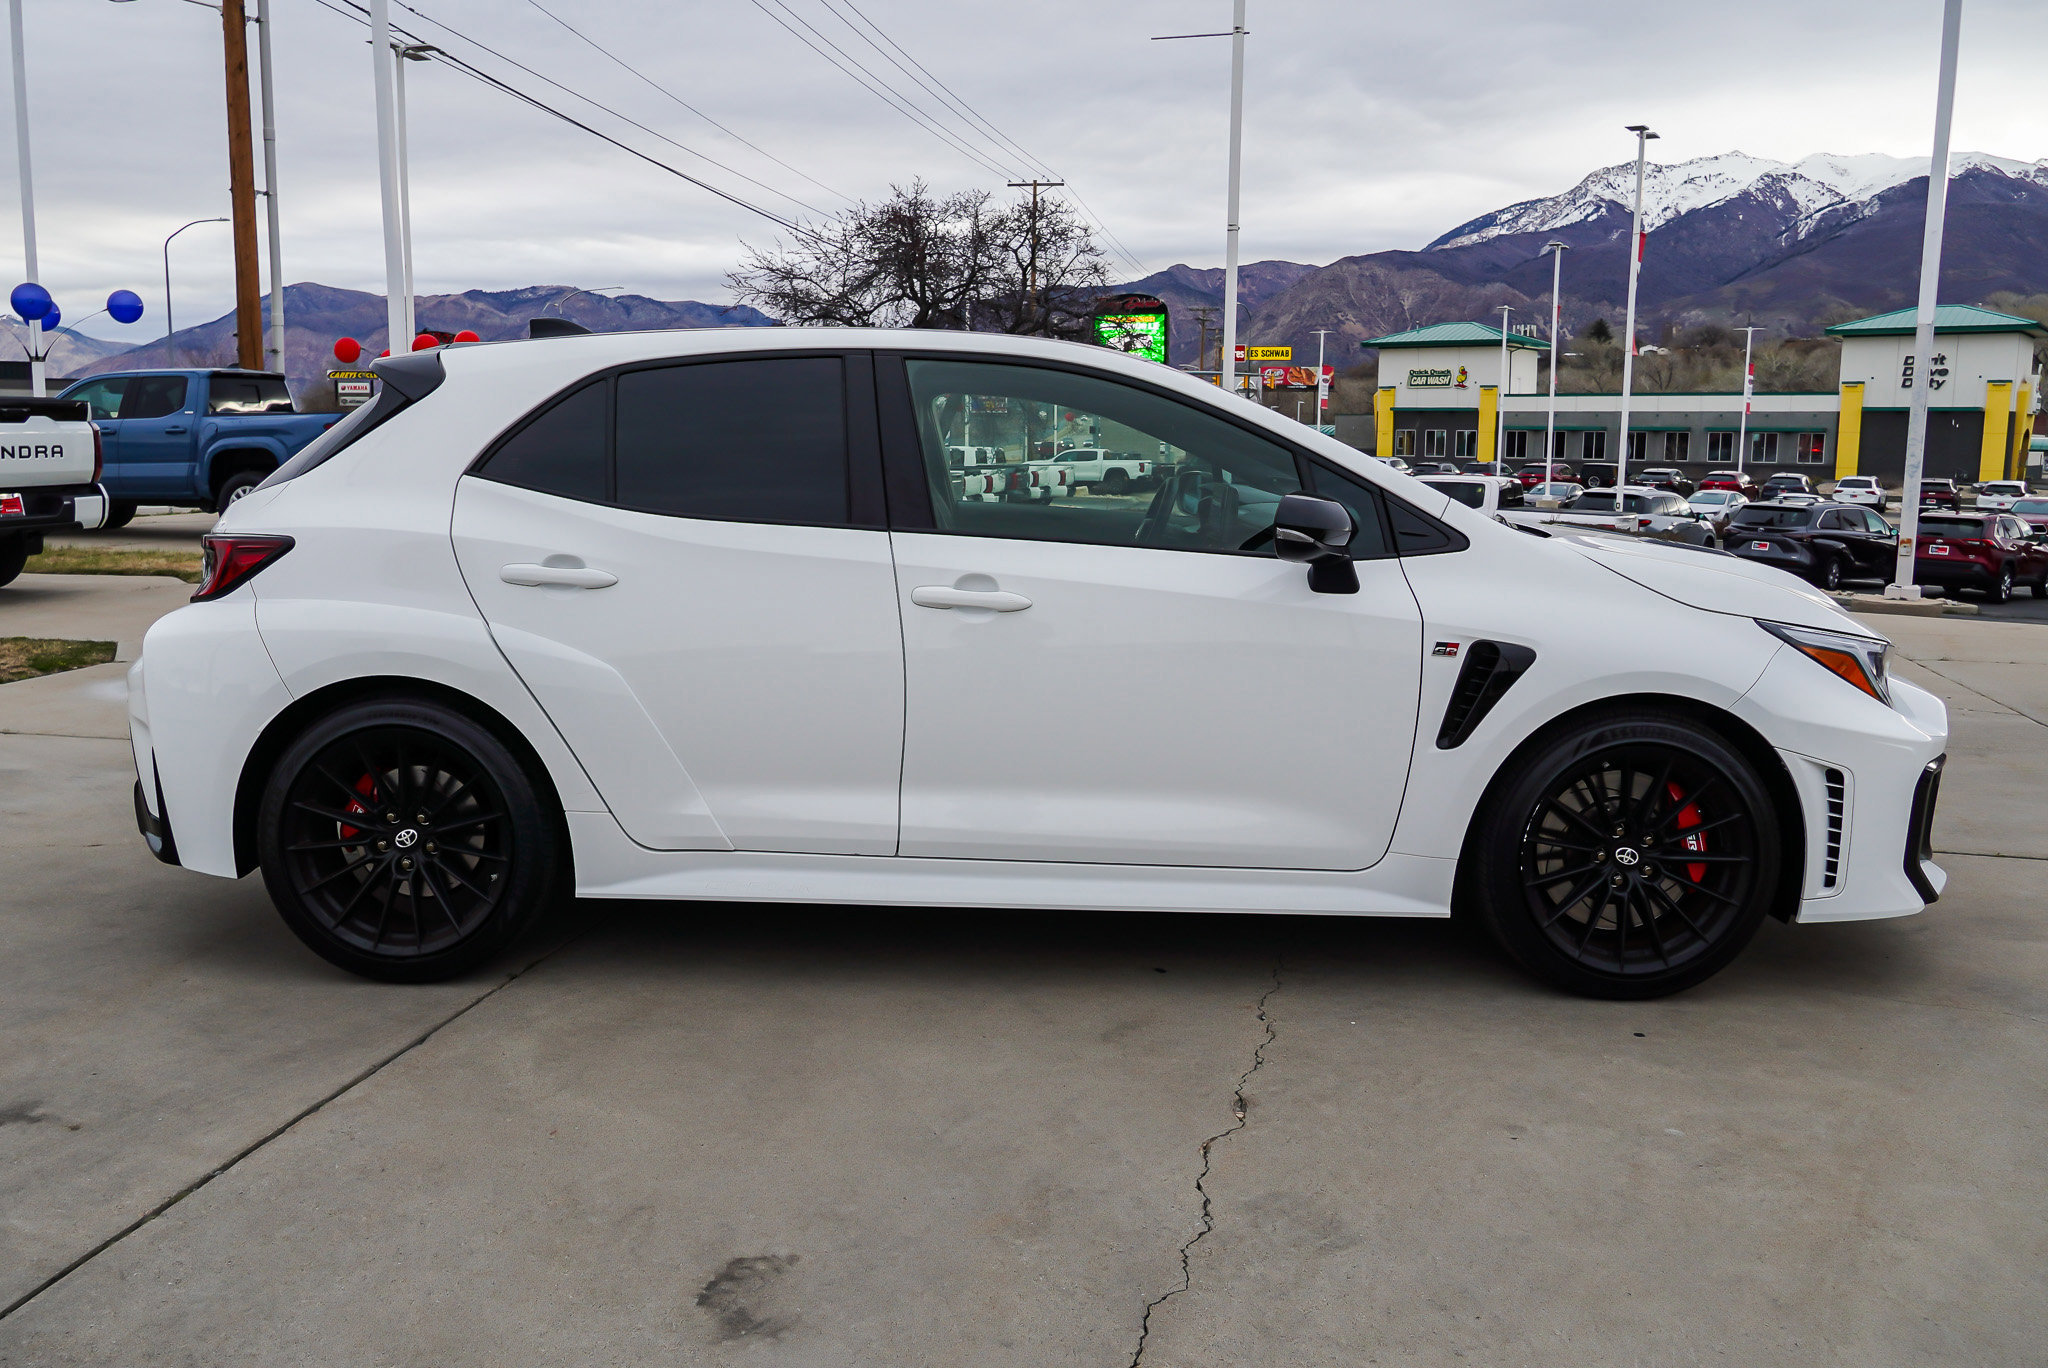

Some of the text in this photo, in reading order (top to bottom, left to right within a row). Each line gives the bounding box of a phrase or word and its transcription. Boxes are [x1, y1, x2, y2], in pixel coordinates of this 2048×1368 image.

[1261, 349, 1290, 357] SCHWAB
[1903, 353, 1947, 366] Dn't
[1902, 367, 1949, 377] Dve
[1411, 376, 1451, 385] CAR WASH
[1901, 378, 1946, 390] Dty
[1, 445, 63, 459] NDRA
